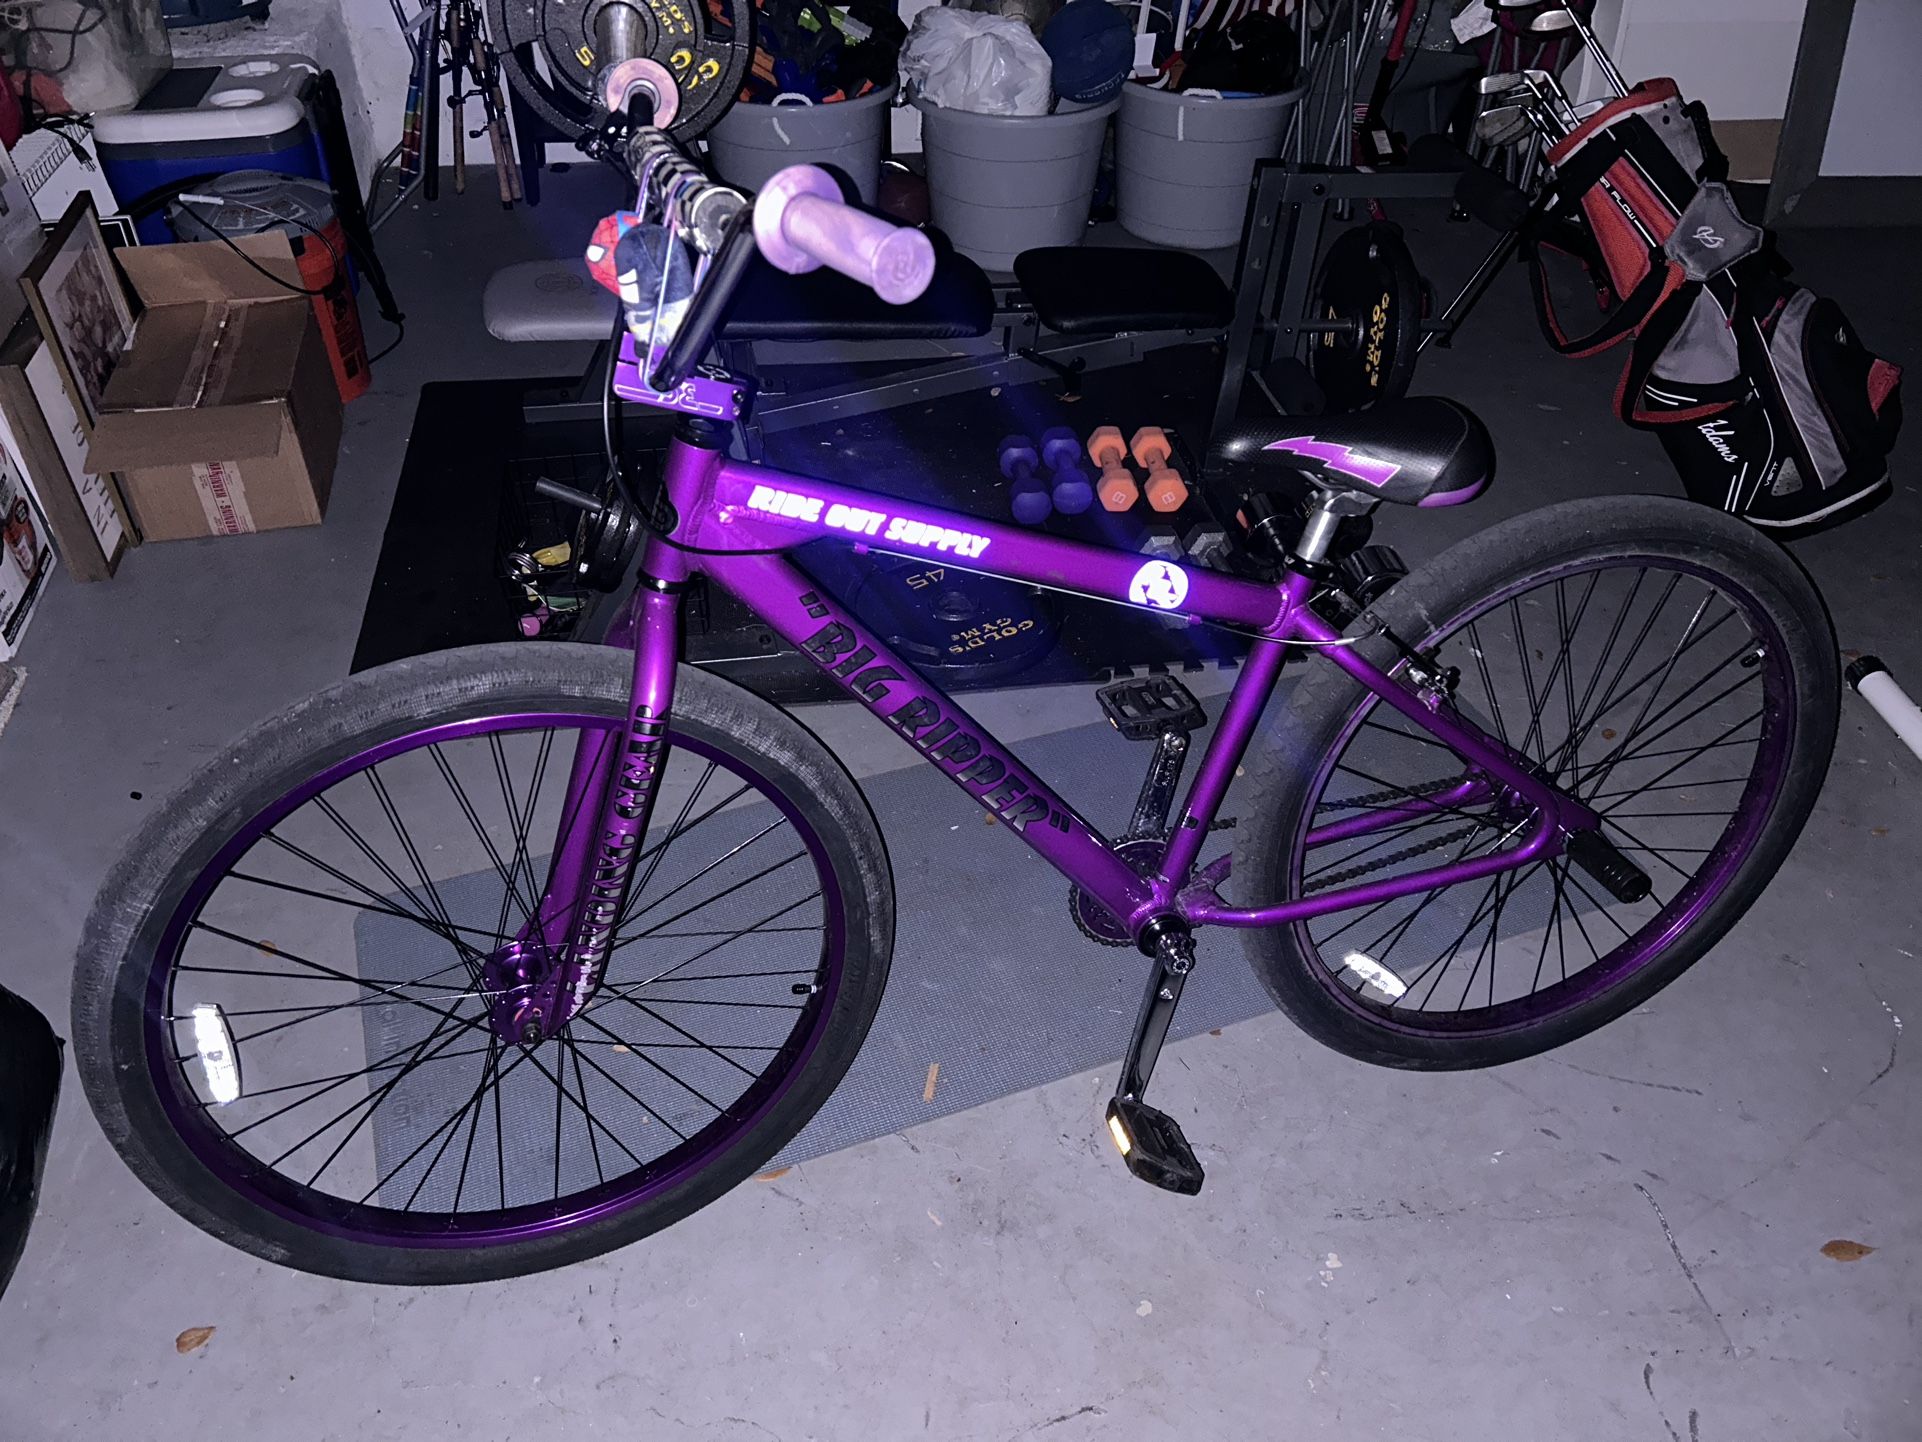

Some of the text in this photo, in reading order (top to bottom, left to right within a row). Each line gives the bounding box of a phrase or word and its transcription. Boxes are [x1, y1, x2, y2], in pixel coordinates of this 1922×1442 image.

[1611, 190, 1636, 220] FLOW
[1370, 292, 1390, 387] GOLD'S
[746, 484, 992, 559] RIDE OUT SUPPLY
[905, 568, 945, 590] 45
[948, 619, 1034, 655] GOLD'S
